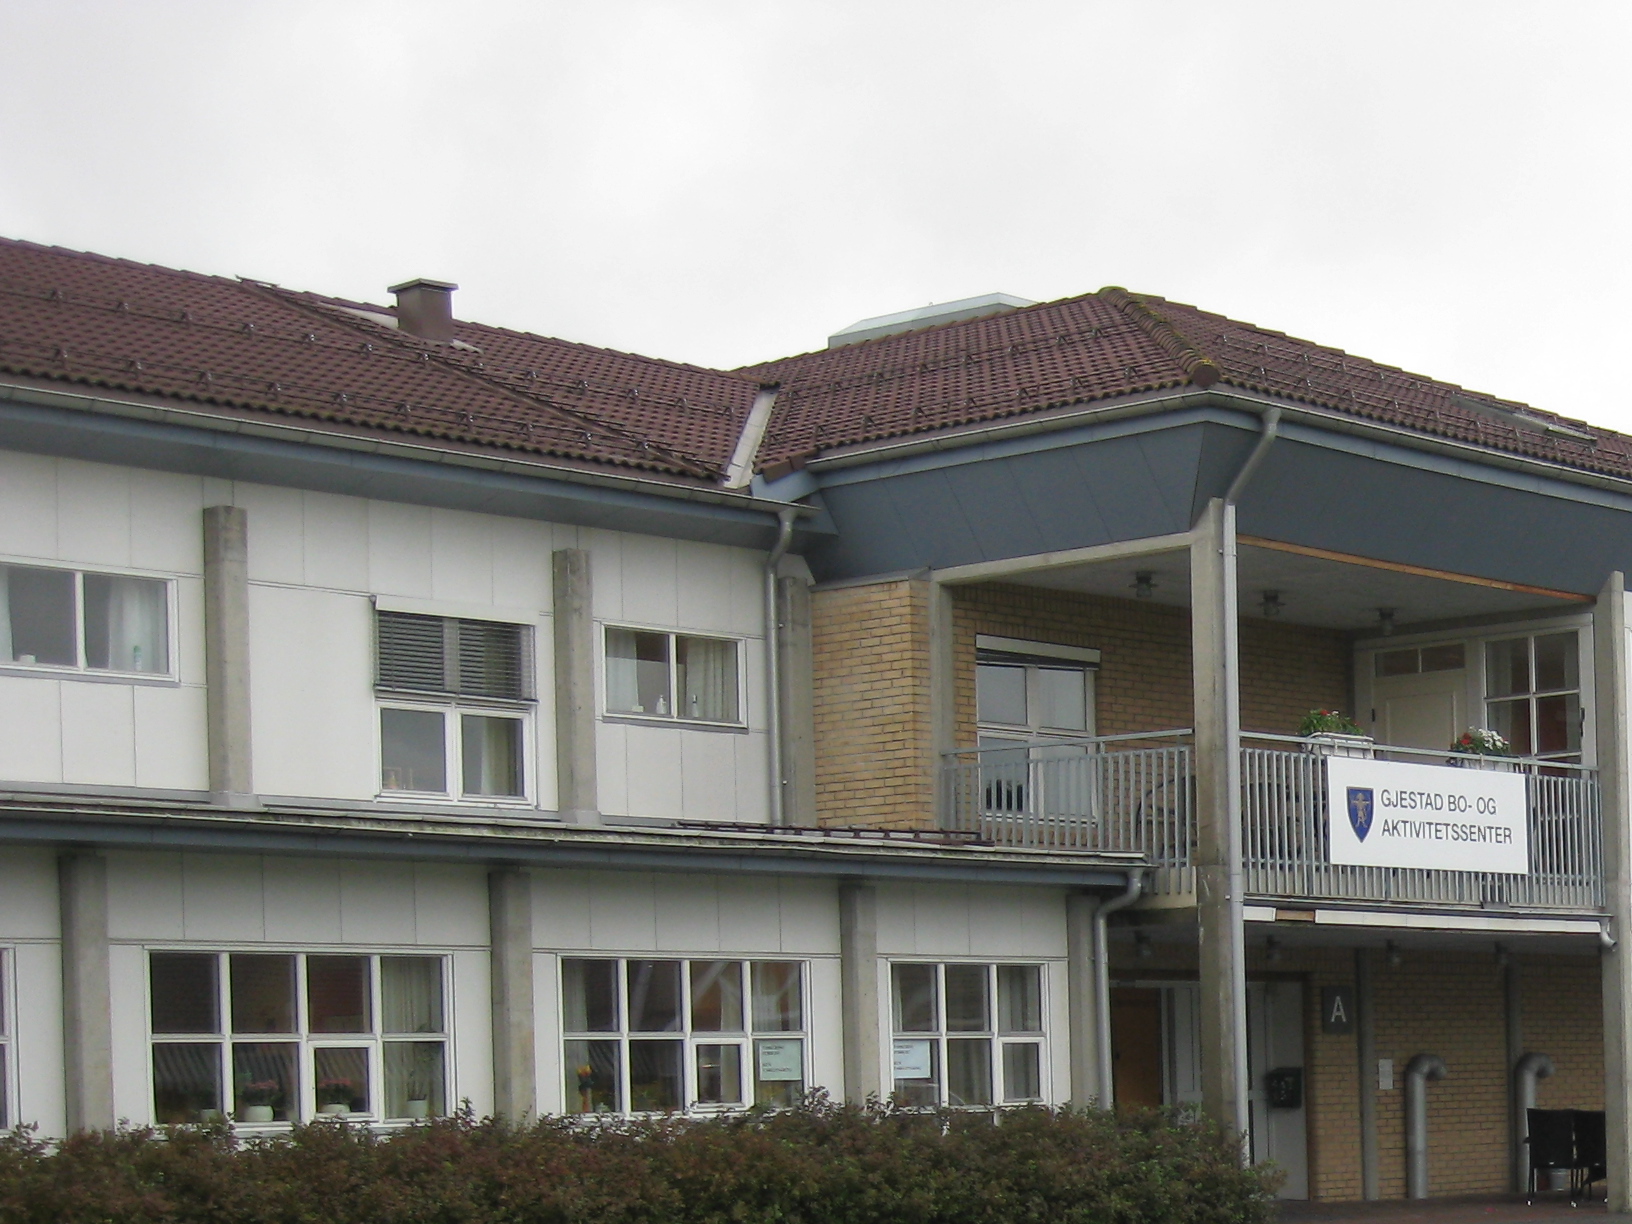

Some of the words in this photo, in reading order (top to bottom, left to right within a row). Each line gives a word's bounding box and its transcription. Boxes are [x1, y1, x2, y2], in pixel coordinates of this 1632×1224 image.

[1380, 788, 1444, 811] GJESTAD
[1447, 794, 1473, 813] BO-
[1476, 797, 1497, 815] OG
[1381, 818, 1512, 844] AKTIVITETSSENTER
[1330, 996, 1347, 1023] A
